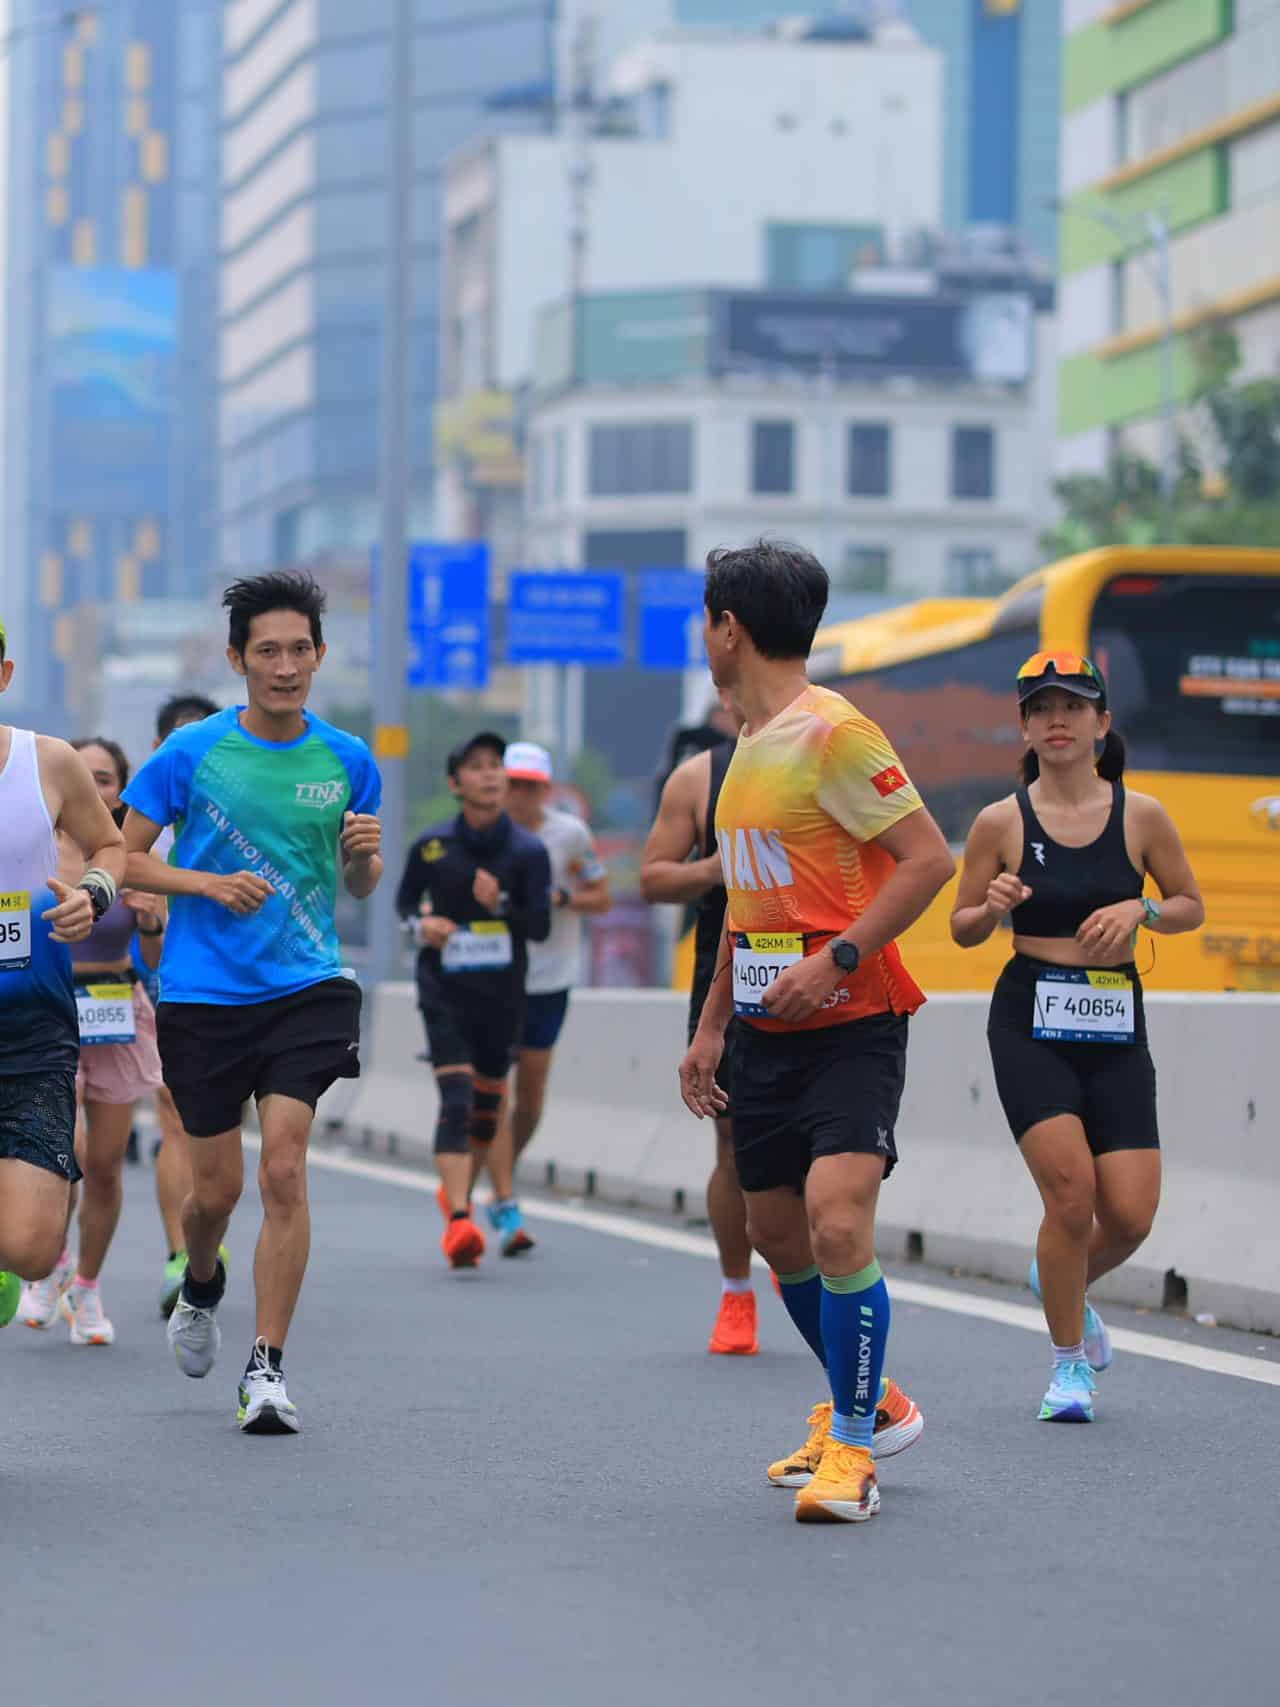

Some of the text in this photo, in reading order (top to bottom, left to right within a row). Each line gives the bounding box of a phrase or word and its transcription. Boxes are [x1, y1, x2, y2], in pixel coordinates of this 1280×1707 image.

[755, 937, 784, 949] 42KM
[739, 964, 793, 987] 4007
[1046, 995, 1126, 1017] F 40654
